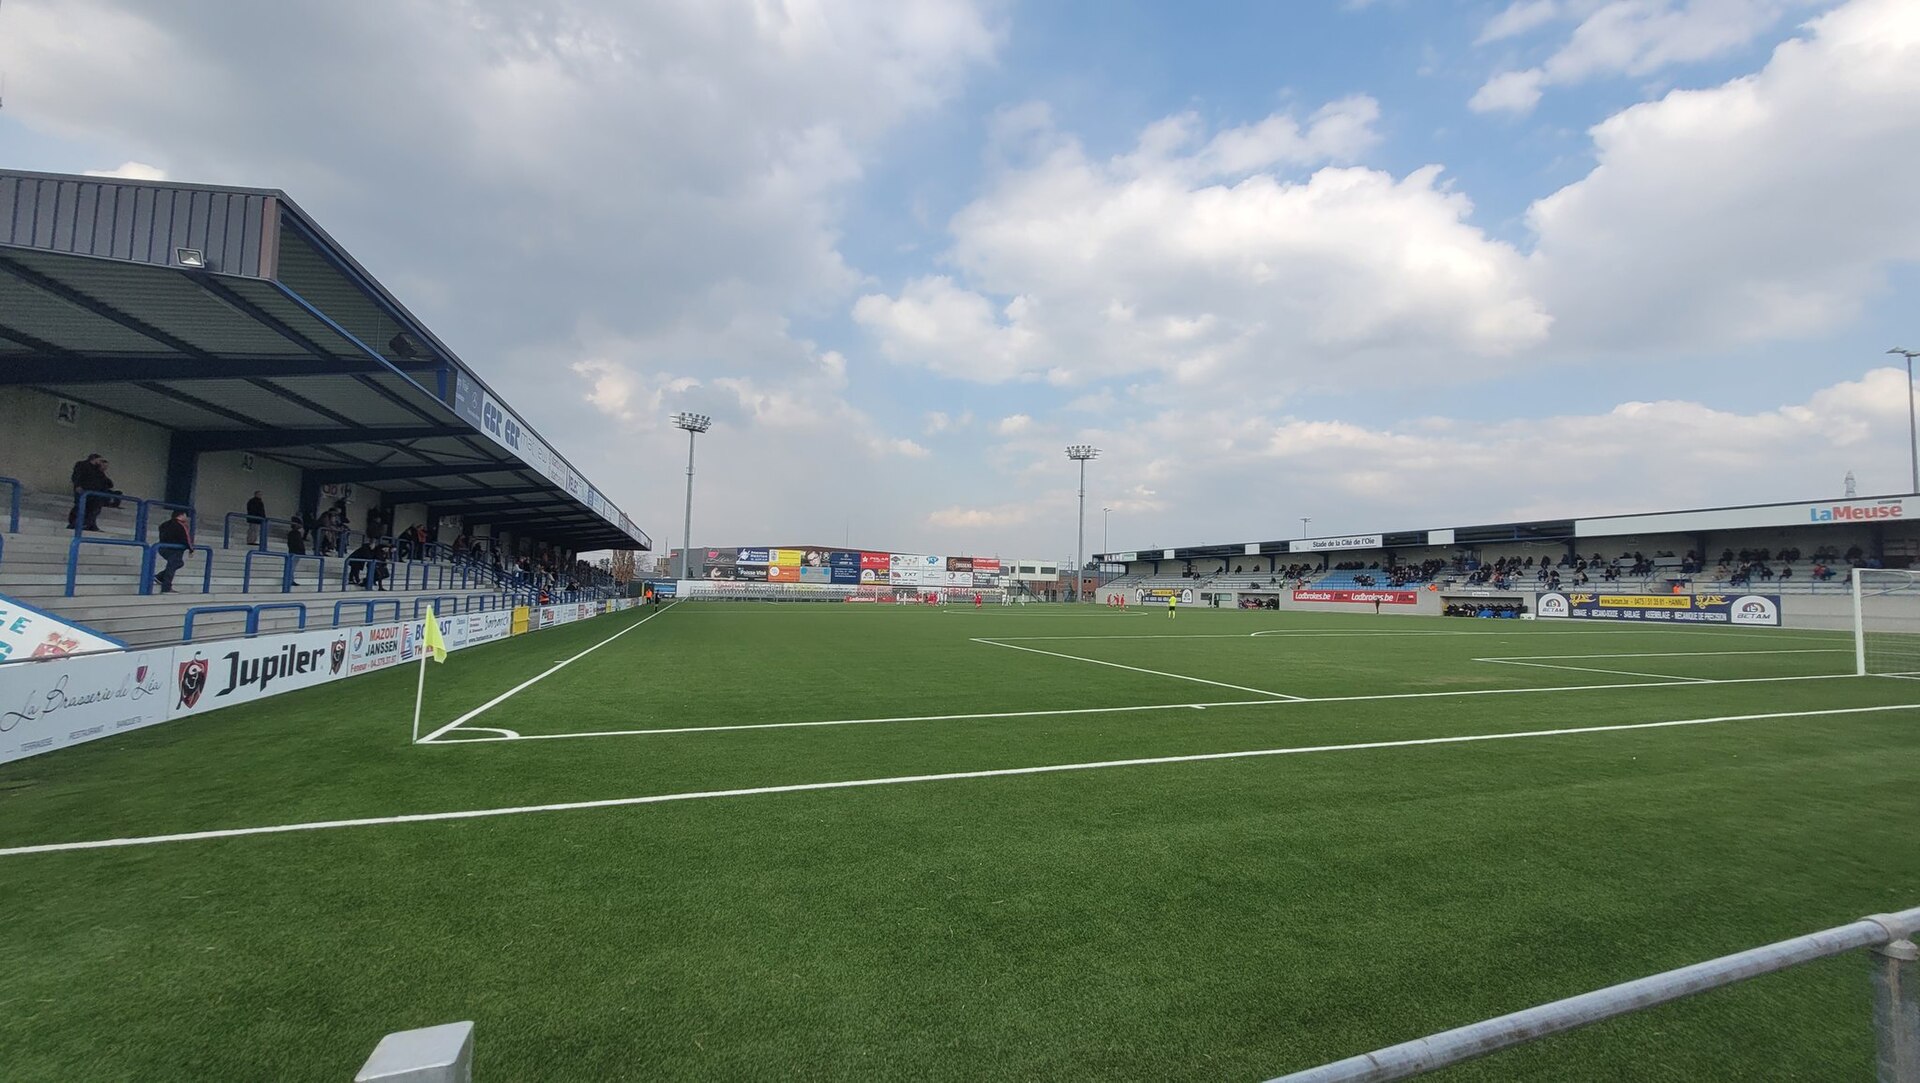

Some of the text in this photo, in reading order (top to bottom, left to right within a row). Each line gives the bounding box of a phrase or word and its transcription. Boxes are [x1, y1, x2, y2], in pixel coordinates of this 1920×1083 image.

[1362, 537, 1375, 545] l'Oie
[1295, 591, 1331, 600] Ladbrokes.be
[1351, 592, 1393, 602] Ladbrokes.be
[369, 626, 399, 641] MAZOUT
[365, 640, 398, 657] JANSSEN
[215, 644, 326, 697] Jupiler
[41, 674, 113, 719] Brasserie
